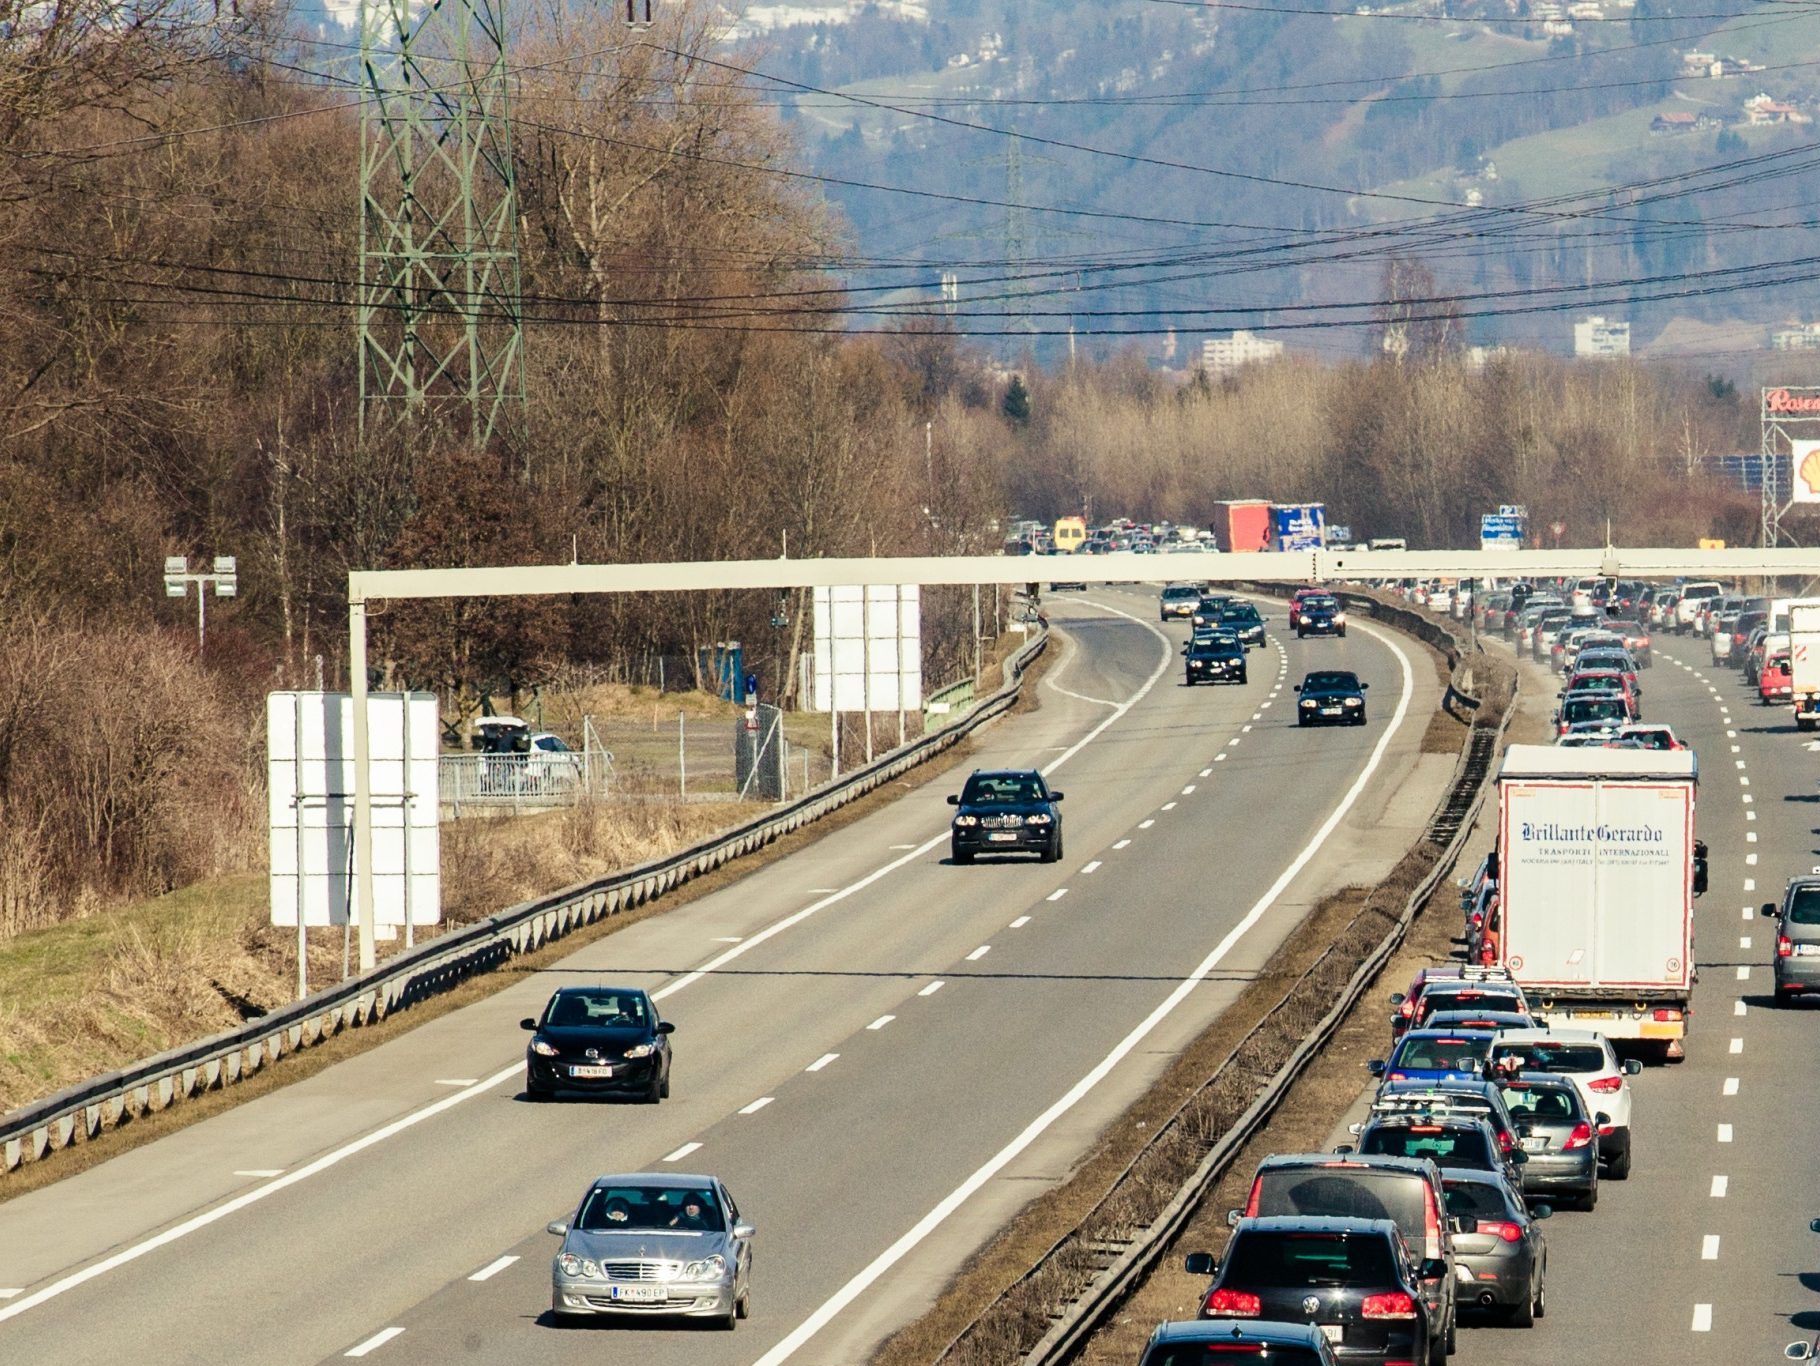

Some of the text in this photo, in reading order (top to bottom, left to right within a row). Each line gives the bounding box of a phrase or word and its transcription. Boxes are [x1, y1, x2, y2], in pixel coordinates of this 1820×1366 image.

[1522, 822, 1663, 842] Brillante Gerardo
[1538, 848, 1669, 857] TRASPORTI INTERNAZIONALI
